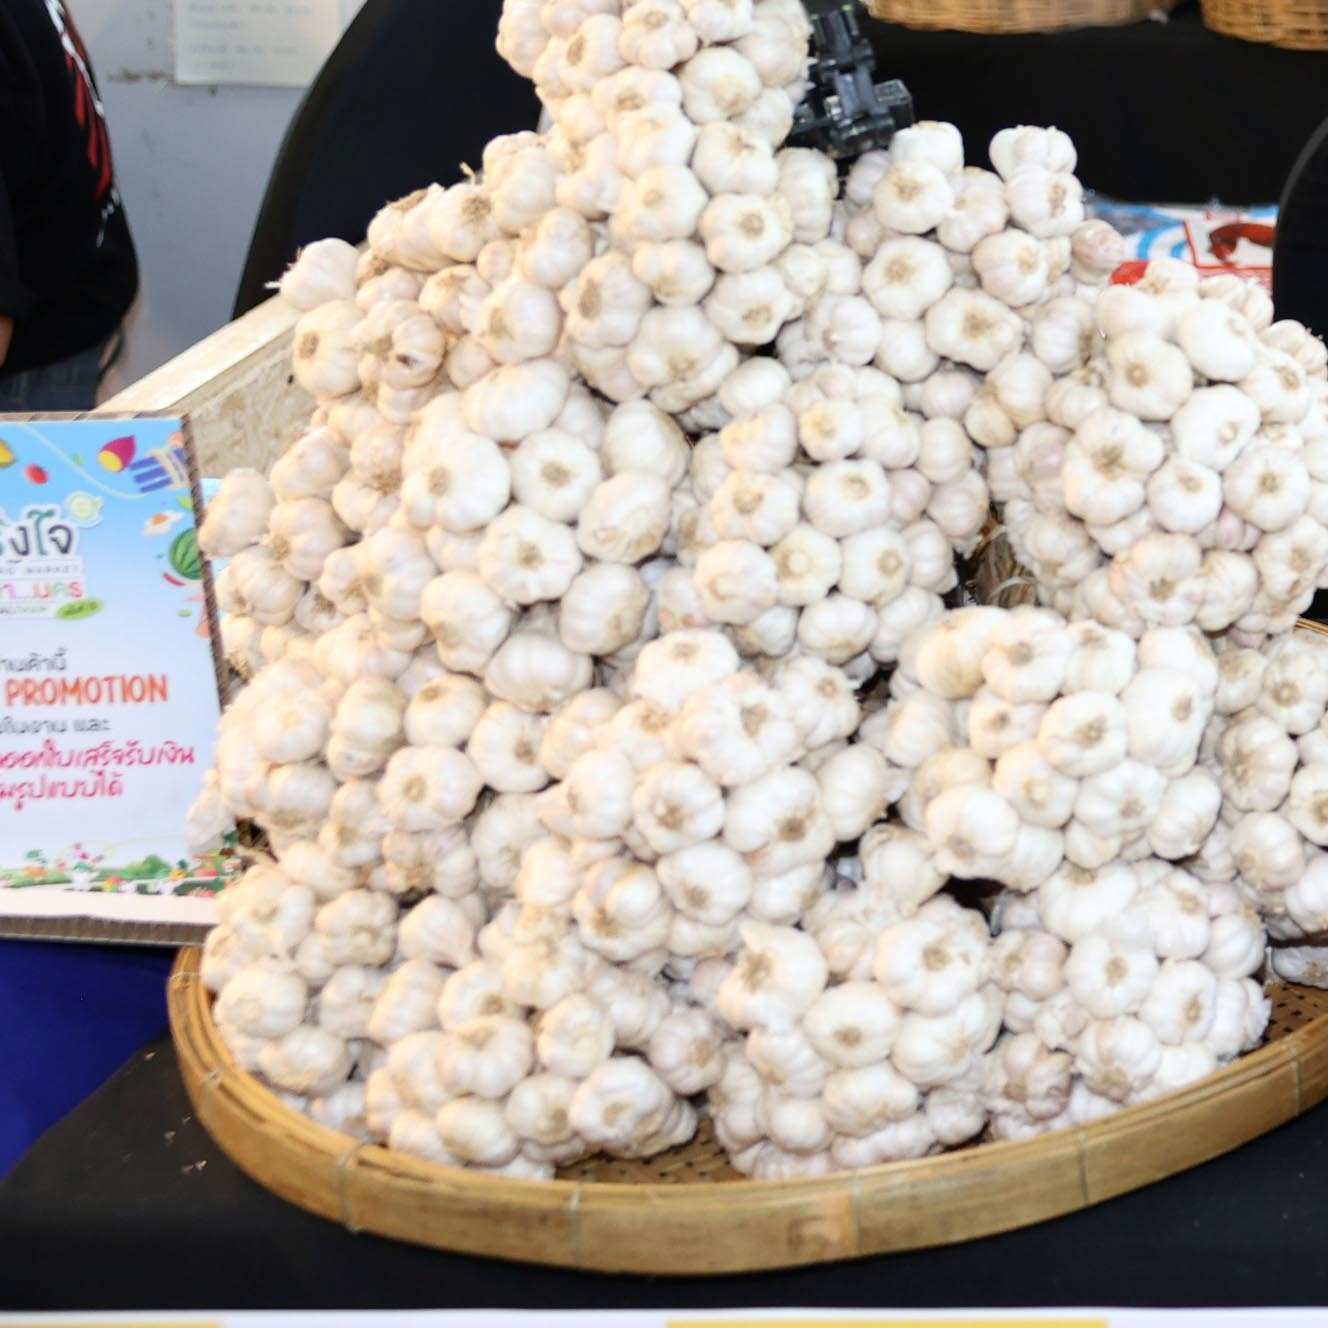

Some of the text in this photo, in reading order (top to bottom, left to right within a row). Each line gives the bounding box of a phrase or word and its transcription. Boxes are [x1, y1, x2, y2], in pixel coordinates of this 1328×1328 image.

[5, 674, 169, 708] PROMOTION
[0, 738, 195, 769] ออกใบเสร็จรับเงิน
